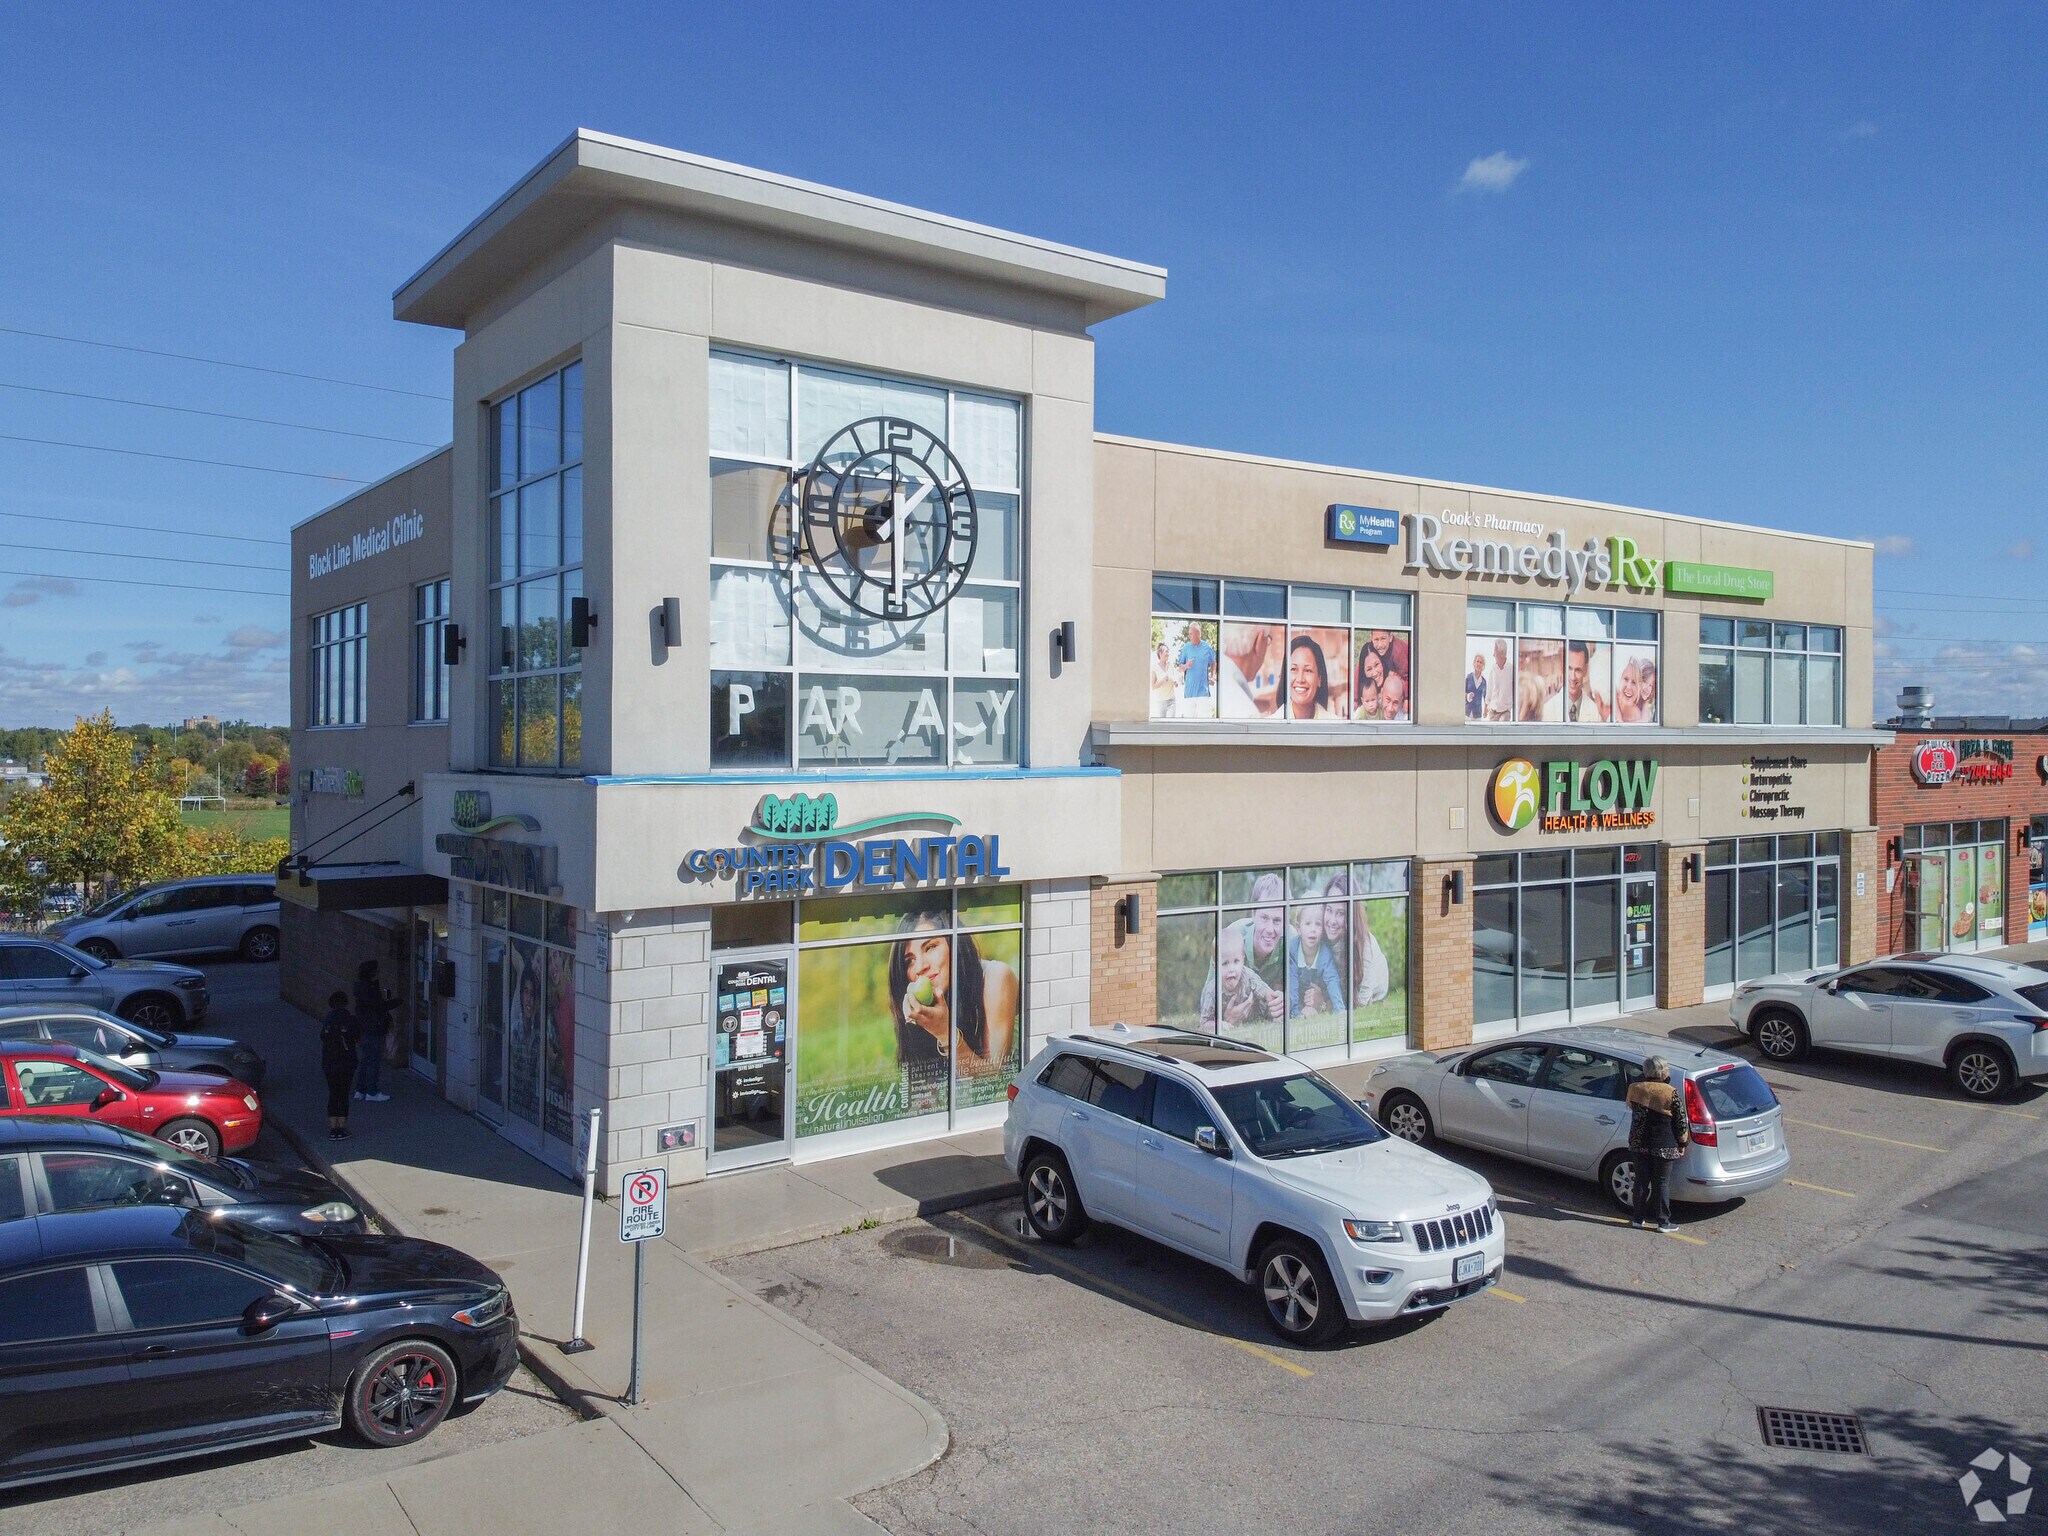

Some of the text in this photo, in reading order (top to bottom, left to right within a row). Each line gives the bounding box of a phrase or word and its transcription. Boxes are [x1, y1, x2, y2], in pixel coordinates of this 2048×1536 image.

[1339, 514, 1356, 531] Rx
[1359, 514, 1396, 529] MyHealth
[1441, 508, 1545, 538] Cook's Pharmacy
[1360, 527, 1383, 537] Program
[309, 509, 424, 580] Block Line Medical Clinic
[1676, 568, 1771, 592] The Local Drug Store
[1926, 740, 1951, 753] TWICE
[1750, 755, 1808, 772] Supplement Store
[1750, 773, 1793, 788] Naturopathic
[1926, 769, 1951, 782] PIZZA
[1547, 760, 1659, 812] FLOW
[1750, 789, 1790, 804] Chiropractic
[1750, 805, 1806, 820] Massage Therapy
[1545, 811, 1657, 830] HEALTH & WELLNESS
[690, 843, 816, 874] COUNTRY
[824, 833, 1011, 888] DENTAL
[748, 867, 816, 893] PARK
[1633, 904, 1652, 915] FLOW
[746, 975, 777, 986] DENTAL
[899, 1061, 909, 1109] confidence
[848, 1088, 869, 1098] smile
[803, 1082, 898, 1125] Health
[814, 1119, 843, 1133] natural
[633, 1204, 653, 1215] FIRE
[626, 1211, 659, 1224] ROUTE
